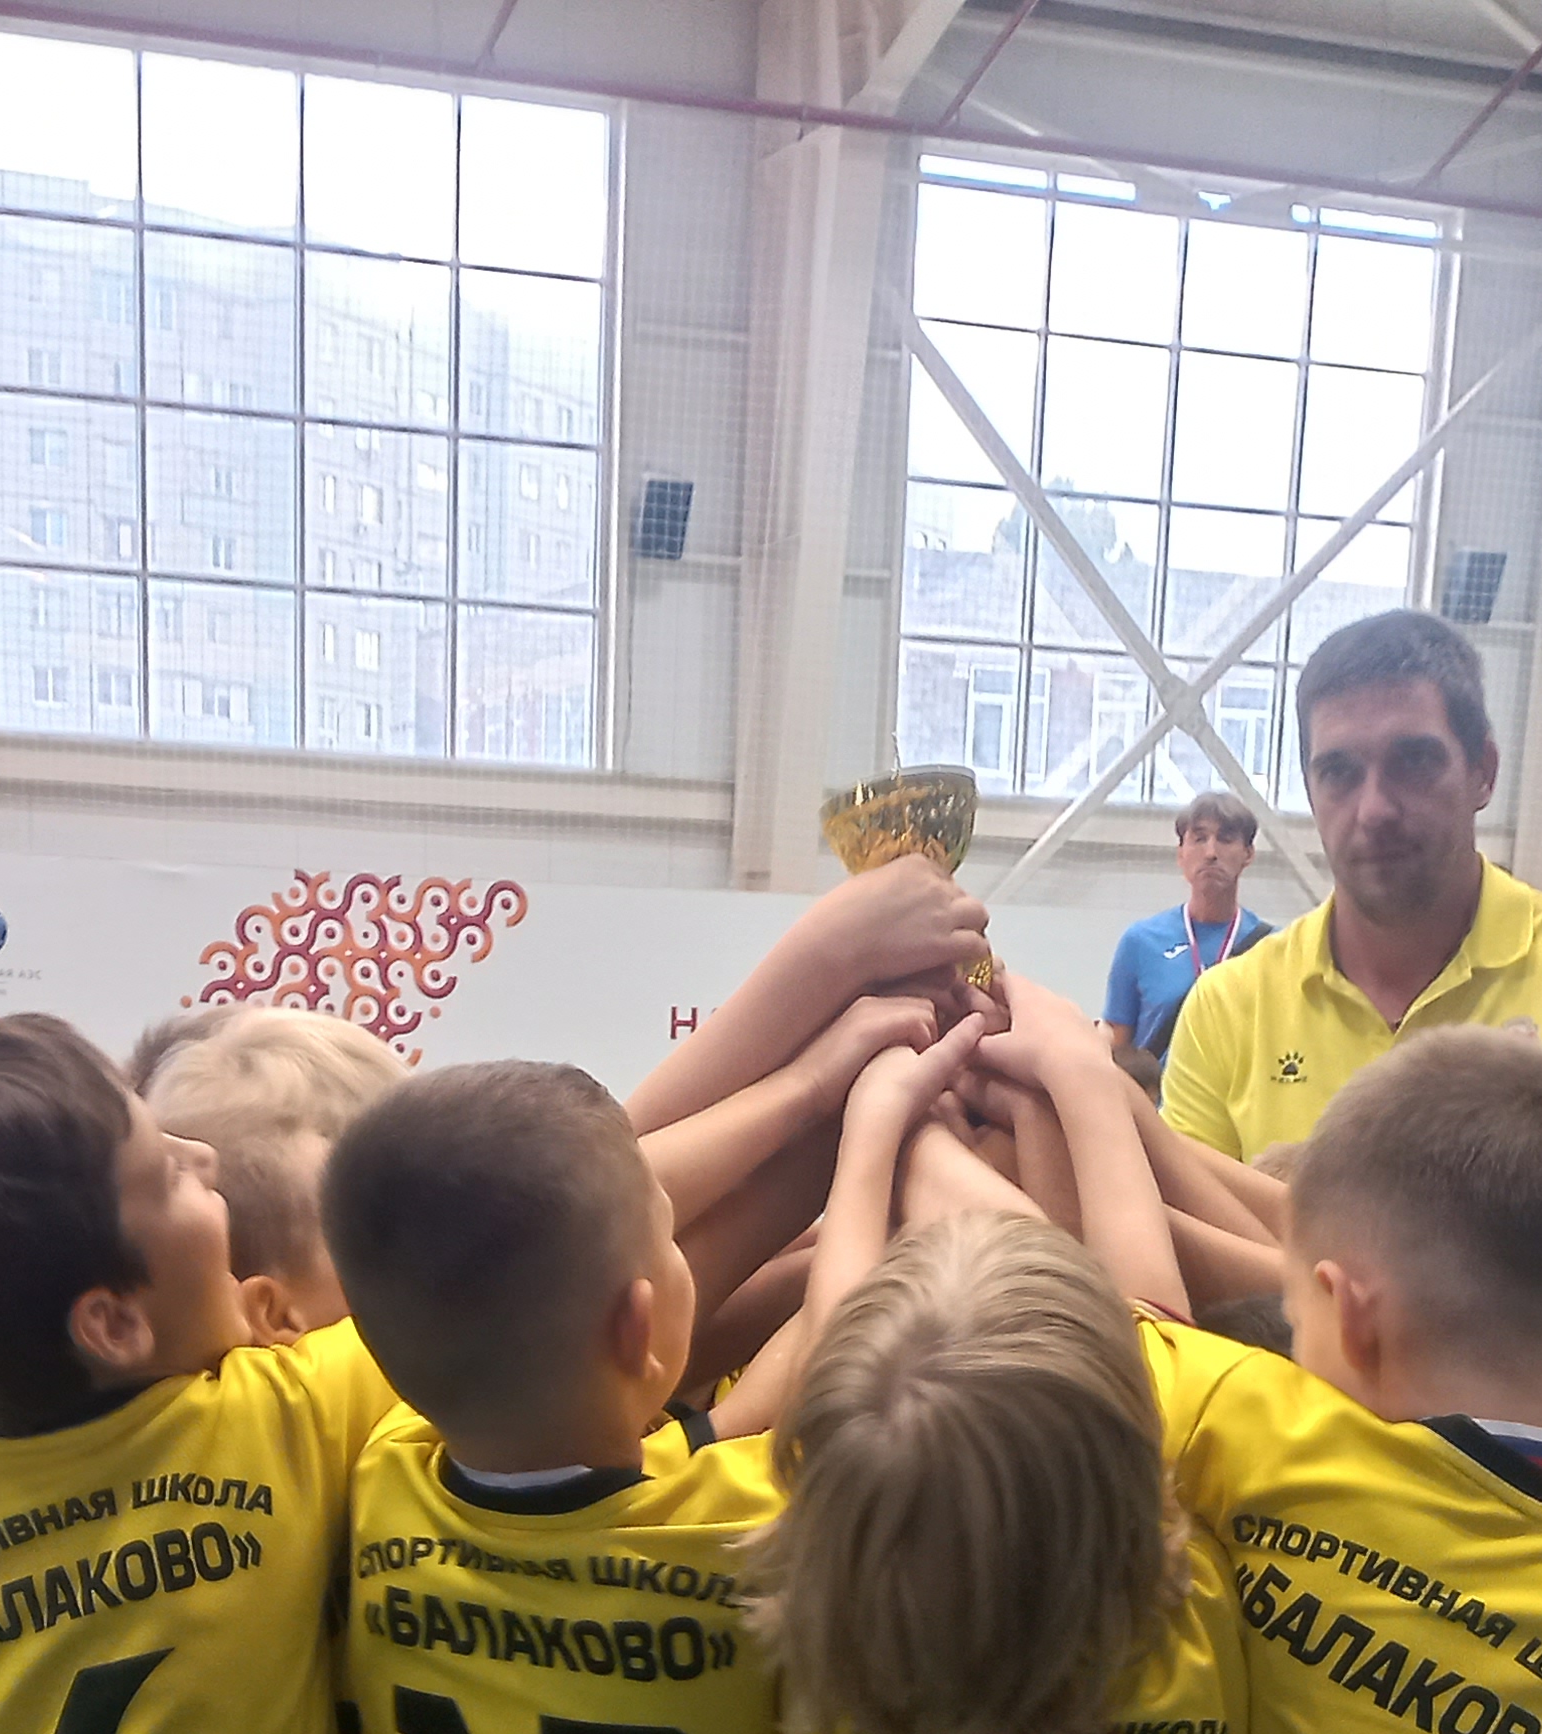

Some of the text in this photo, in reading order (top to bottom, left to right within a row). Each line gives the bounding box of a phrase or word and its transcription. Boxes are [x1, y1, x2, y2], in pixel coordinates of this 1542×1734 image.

[131, 1472, 274, 1516] ШКОЛА
[1232, 1513, 1516, 1649] СПОРТИВНАЯ
[365, 1585, 738, 1682] «БАЛАКОВО»
